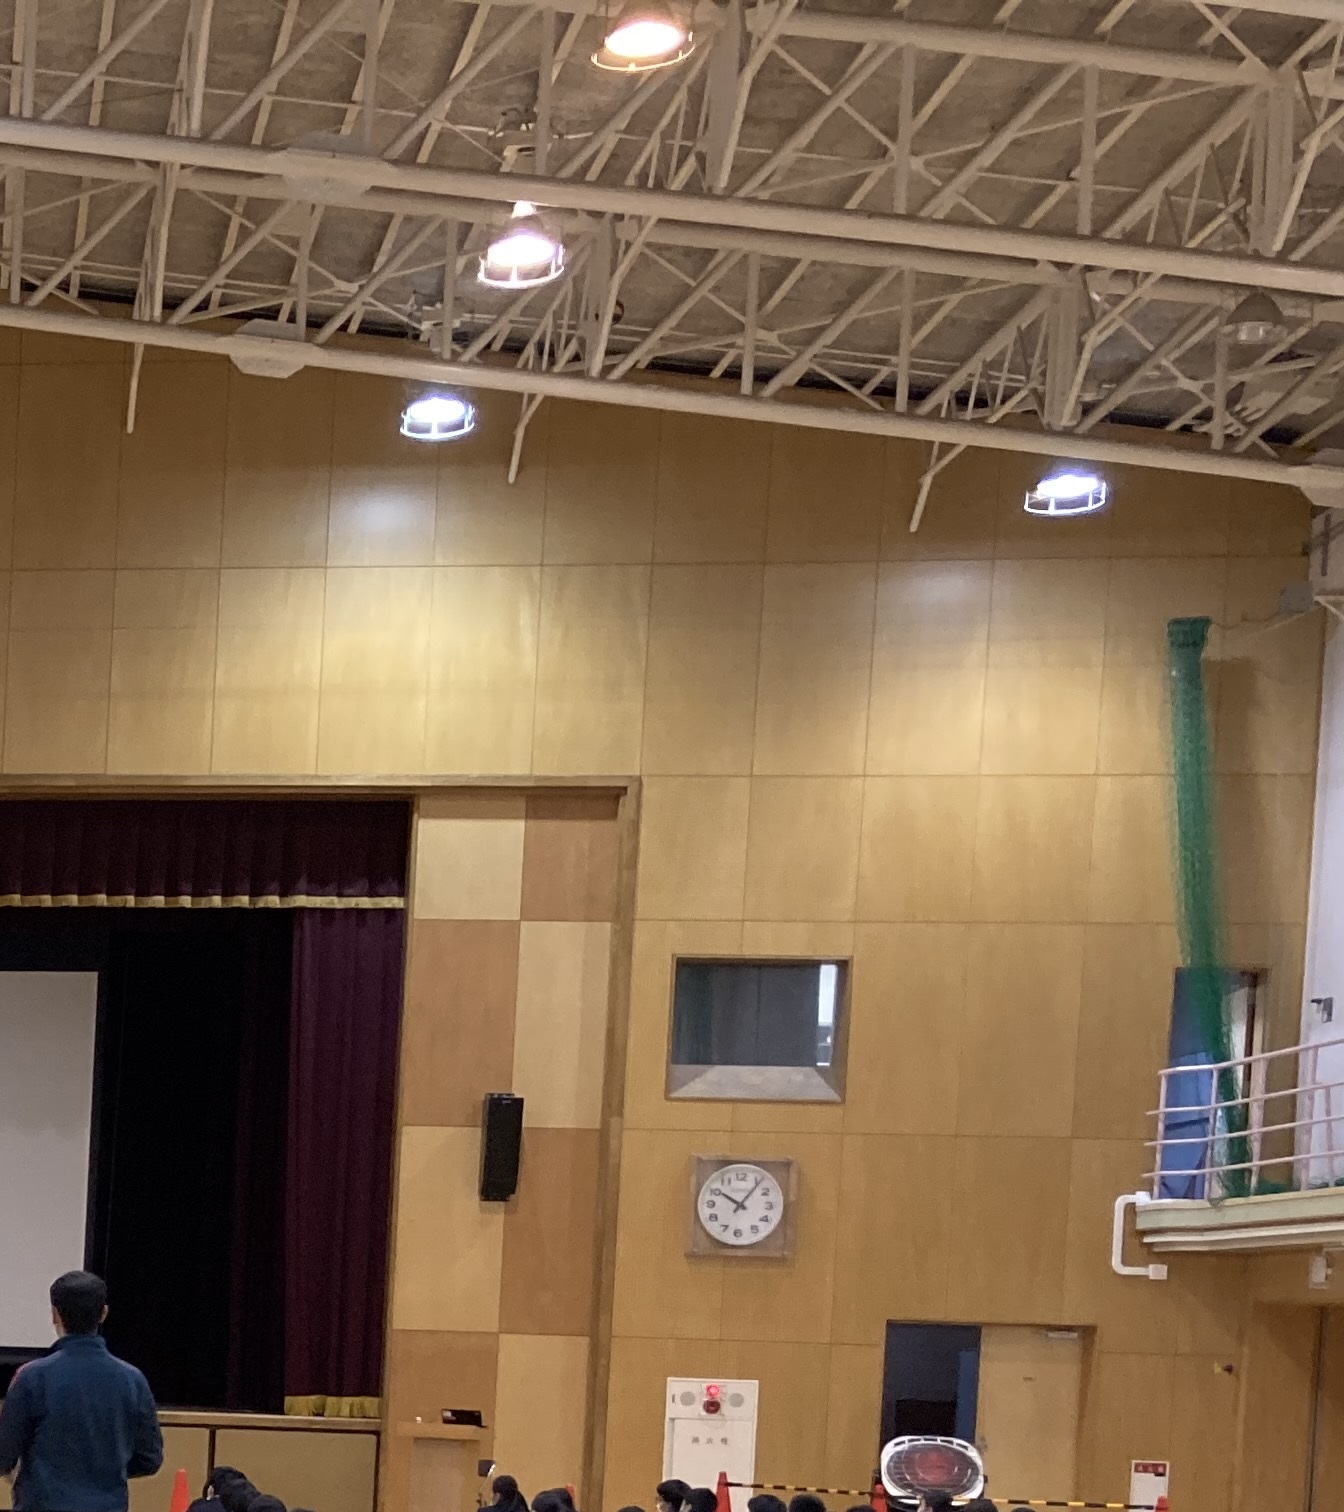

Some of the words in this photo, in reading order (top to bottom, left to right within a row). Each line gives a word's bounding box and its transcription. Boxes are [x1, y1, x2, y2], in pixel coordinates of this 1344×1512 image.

[721, 1177, 732, 1186] 11
[735, 1172, 748, 1182] 12
[709, 1188, 722, 1197] 10
[761, 1187, 770, 1197] 2
[706, 1199, 716, 1209] 9
[764, 1201, 774, 1211] 3
[708, 1213, 718, 1222] 8
[758, 1214, 769, 1223] 4
[720, 1224, 729, 1233] 7
[733, 1228, 743, 1238] 6
[750, 1224, 759, 1234] 5
